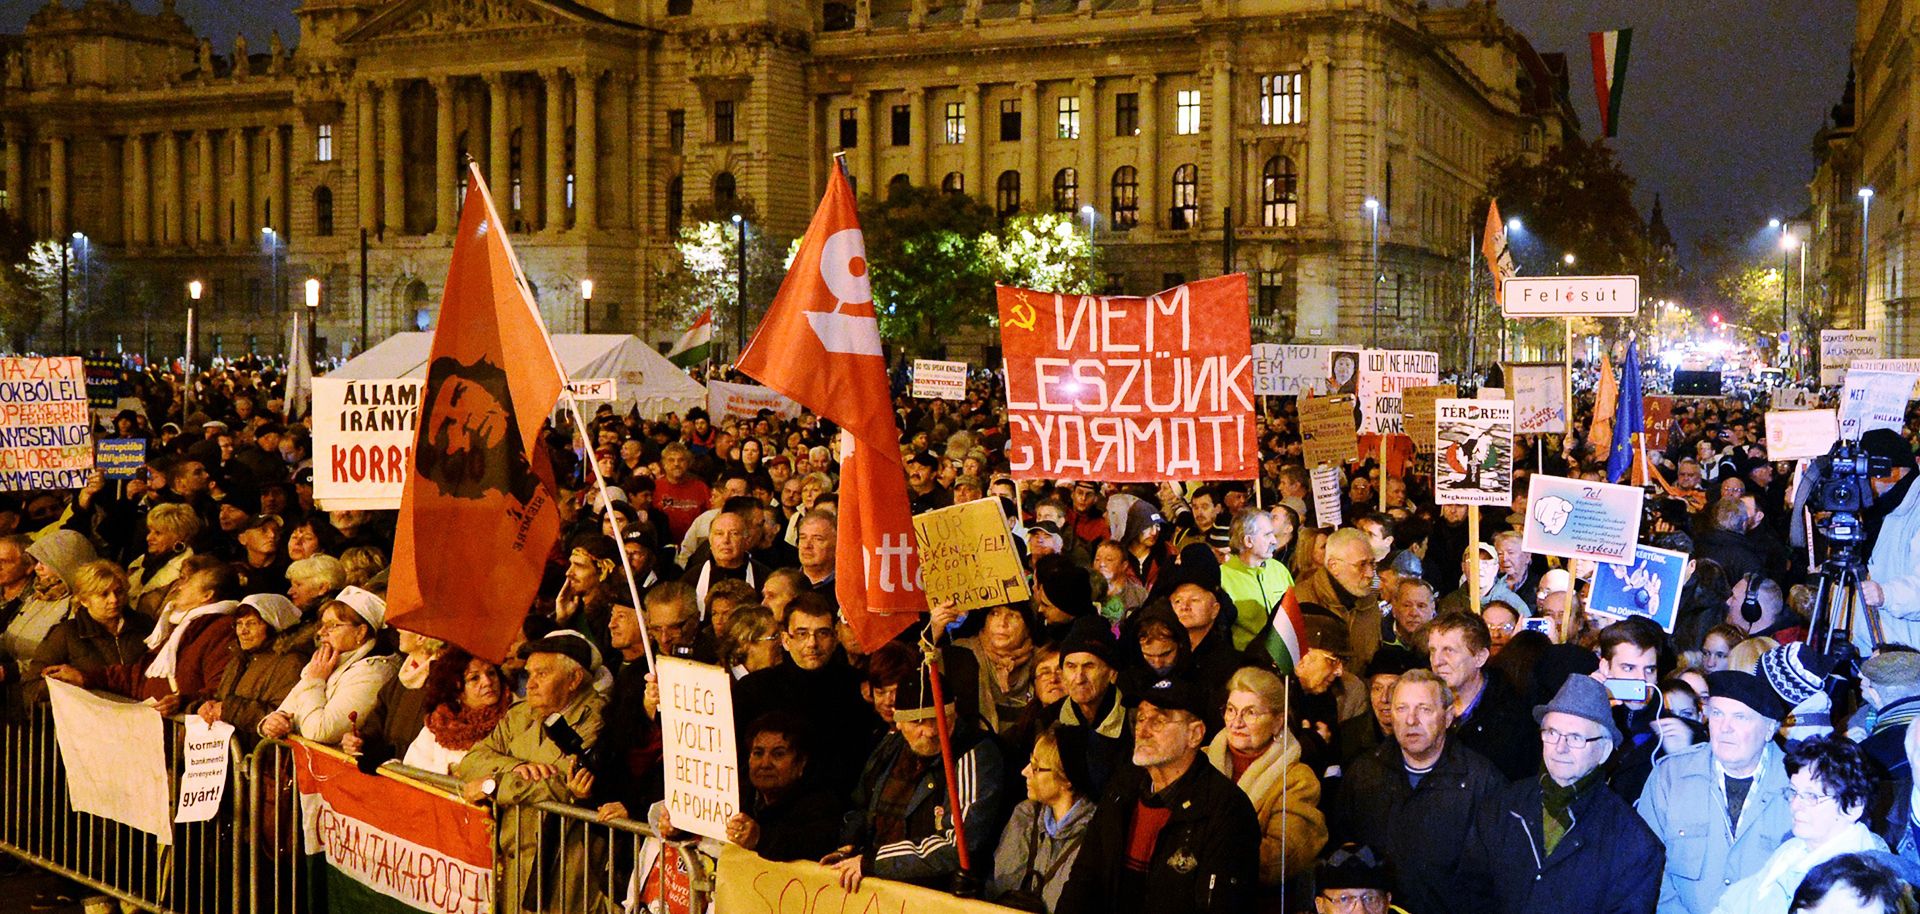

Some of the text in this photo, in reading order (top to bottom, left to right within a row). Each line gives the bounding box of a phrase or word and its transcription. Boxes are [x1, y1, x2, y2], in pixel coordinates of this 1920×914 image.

[343, 380, 425, 406] ÁLLAM
[673, 682, 715, 716] ELÉG
[188, 739, 224, 751] kormány
[673, 719, 722, 753] VOLT!
[675, 754, 734, 793] BETELT
[182, 785, 220, 808] gyárt!
[671, 788, 681, 813] A
